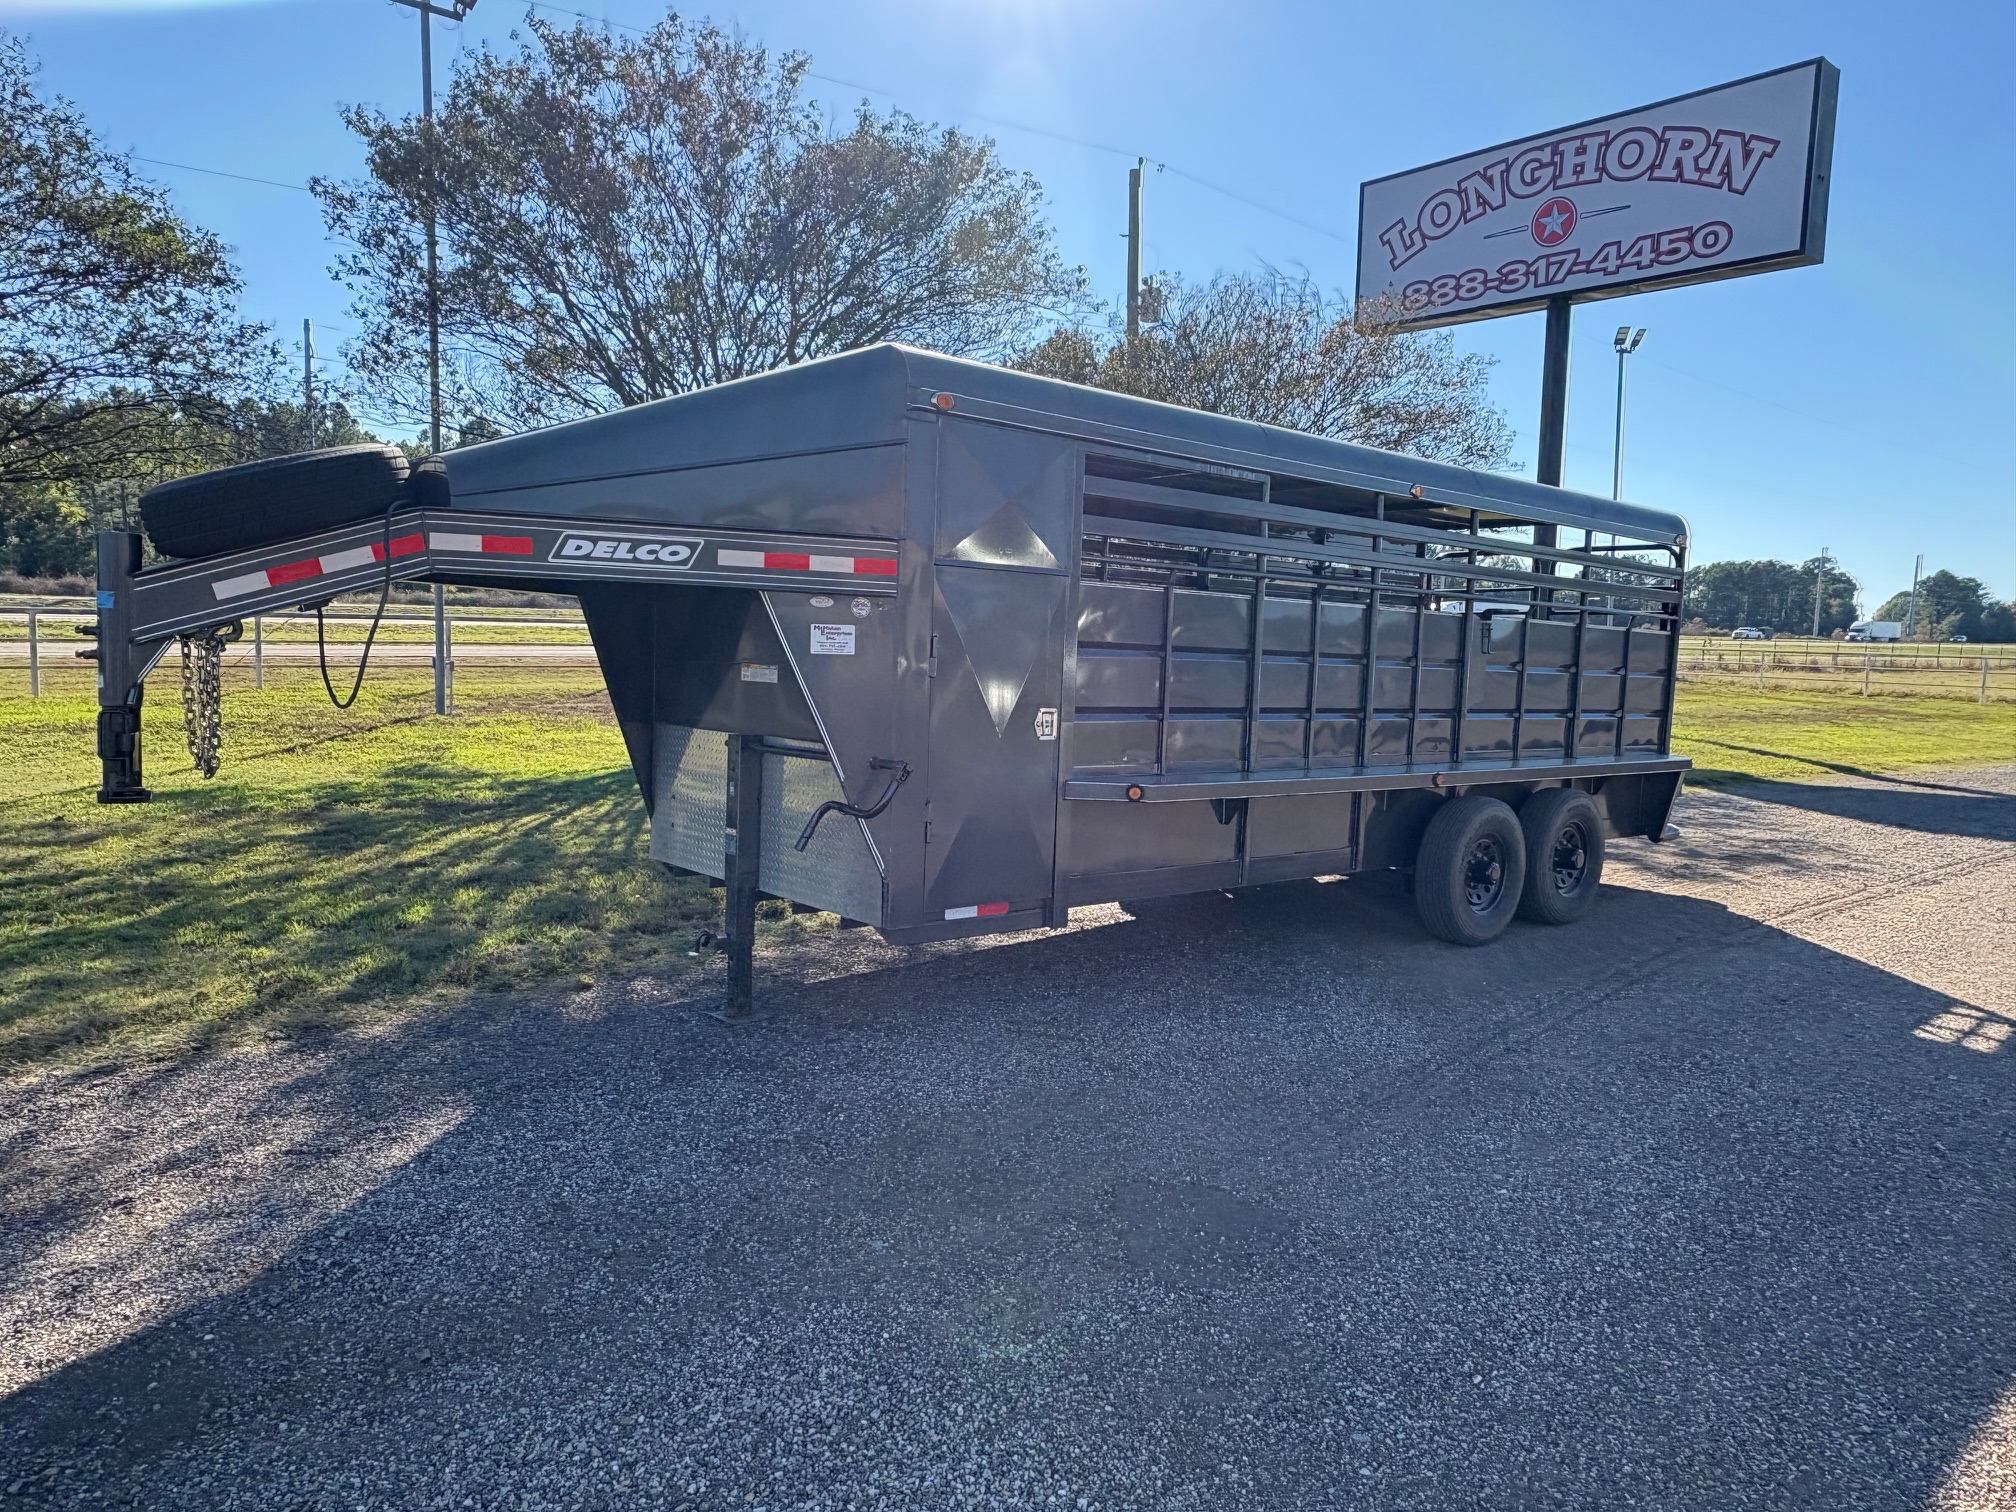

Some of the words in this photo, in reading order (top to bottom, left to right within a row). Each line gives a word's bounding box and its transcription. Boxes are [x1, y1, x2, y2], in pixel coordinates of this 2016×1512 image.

[1379, 126, 1781, 270] LONGHORN
[1402, 220, 1733, 312] 888-317-4450
[561, 539, 691, 562] DELCO
